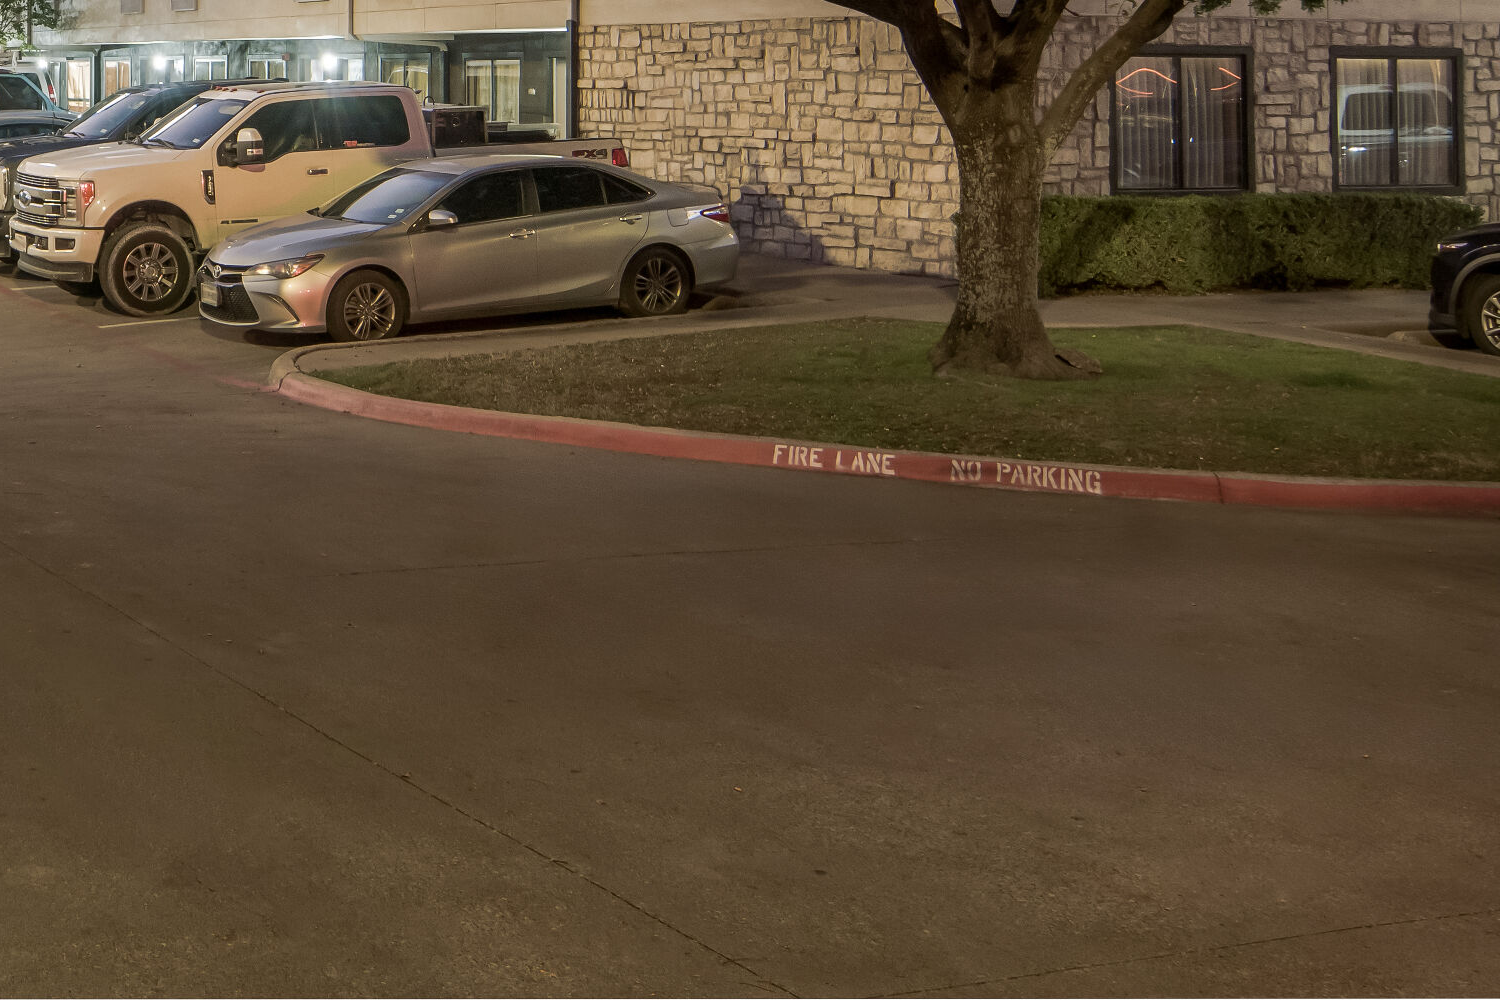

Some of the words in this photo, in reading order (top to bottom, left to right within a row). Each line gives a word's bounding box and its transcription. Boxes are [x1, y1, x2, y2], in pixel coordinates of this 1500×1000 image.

[773, 444, 824, 468] FIRE
[835, 451, 896, 475] LANE
[950, 459, 982, 481] NO
[996, 463, 1102, 494] PARKING
